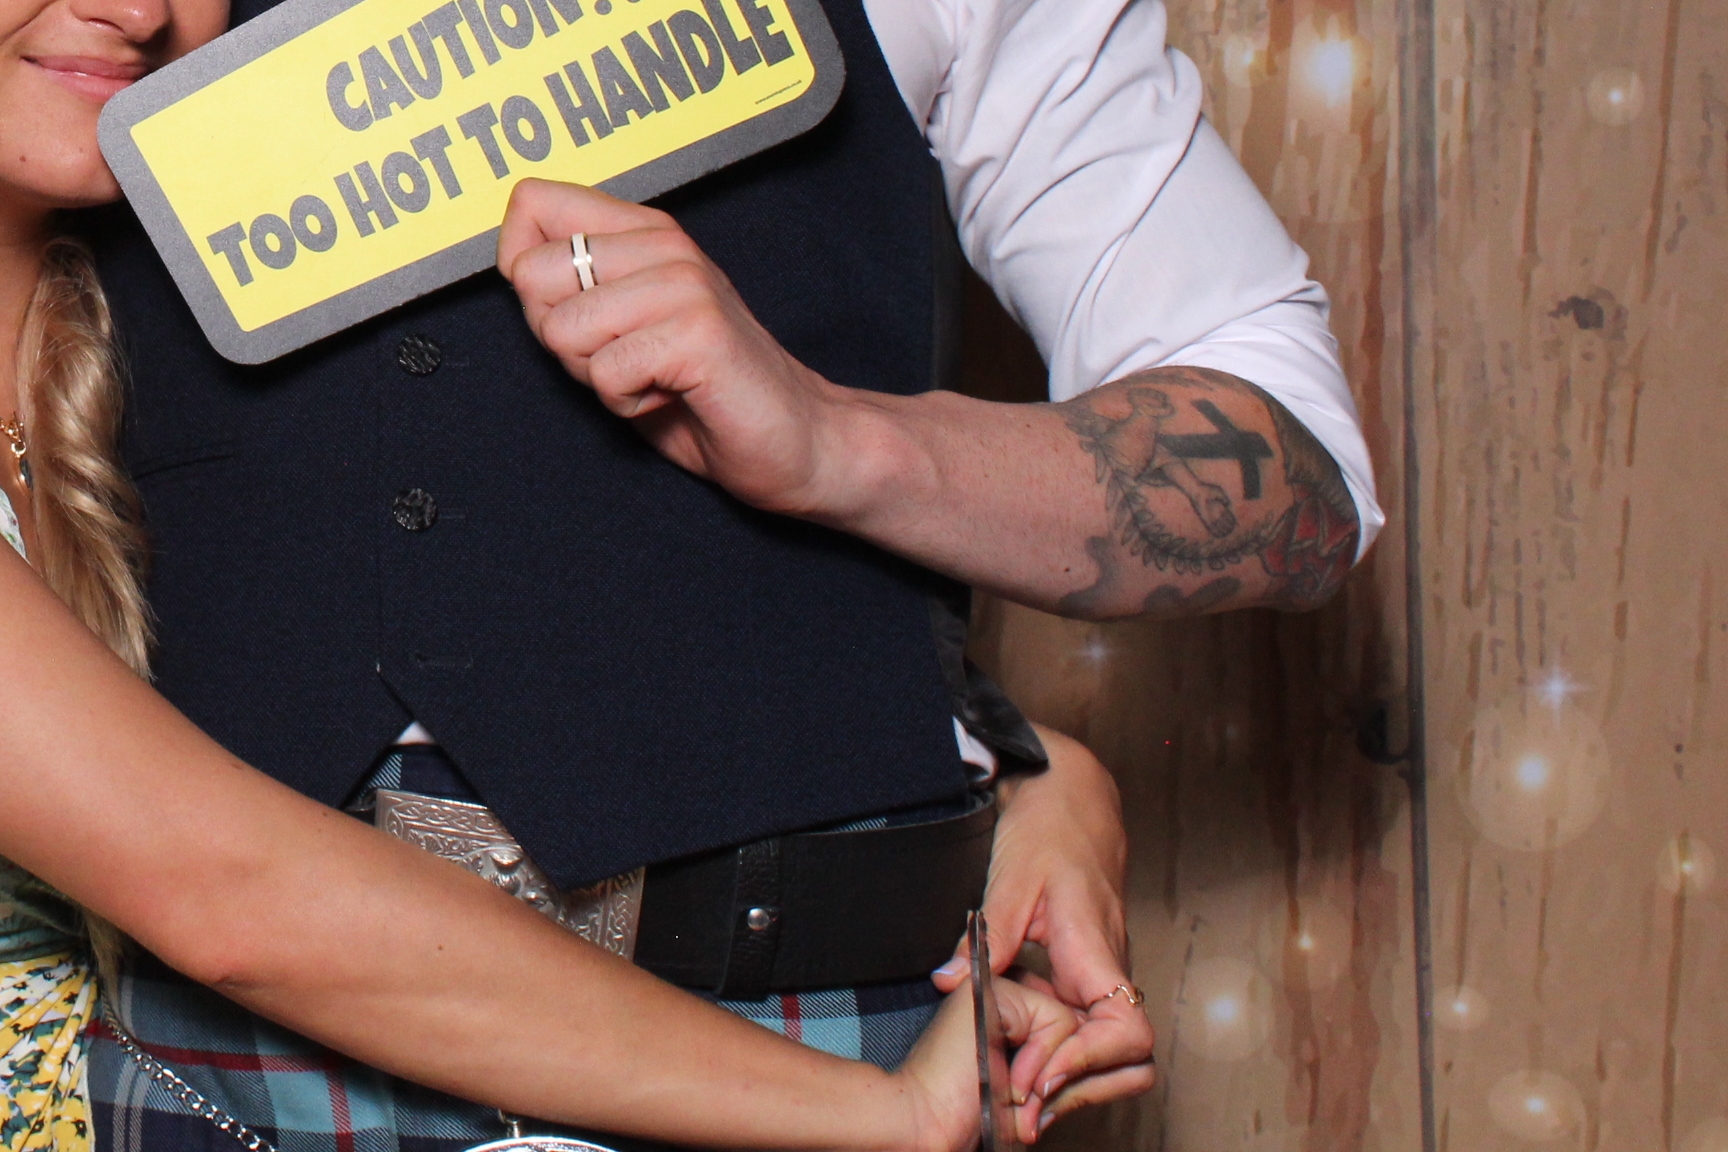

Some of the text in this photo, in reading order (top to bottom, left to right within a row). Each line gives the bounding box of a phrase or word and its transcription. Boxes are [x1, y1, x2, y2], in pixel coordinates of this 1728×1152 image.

[207, 193, 340, 288] TOO
[333, 125, 464, 238] HOT
[457, 95, 554, 180] TO
